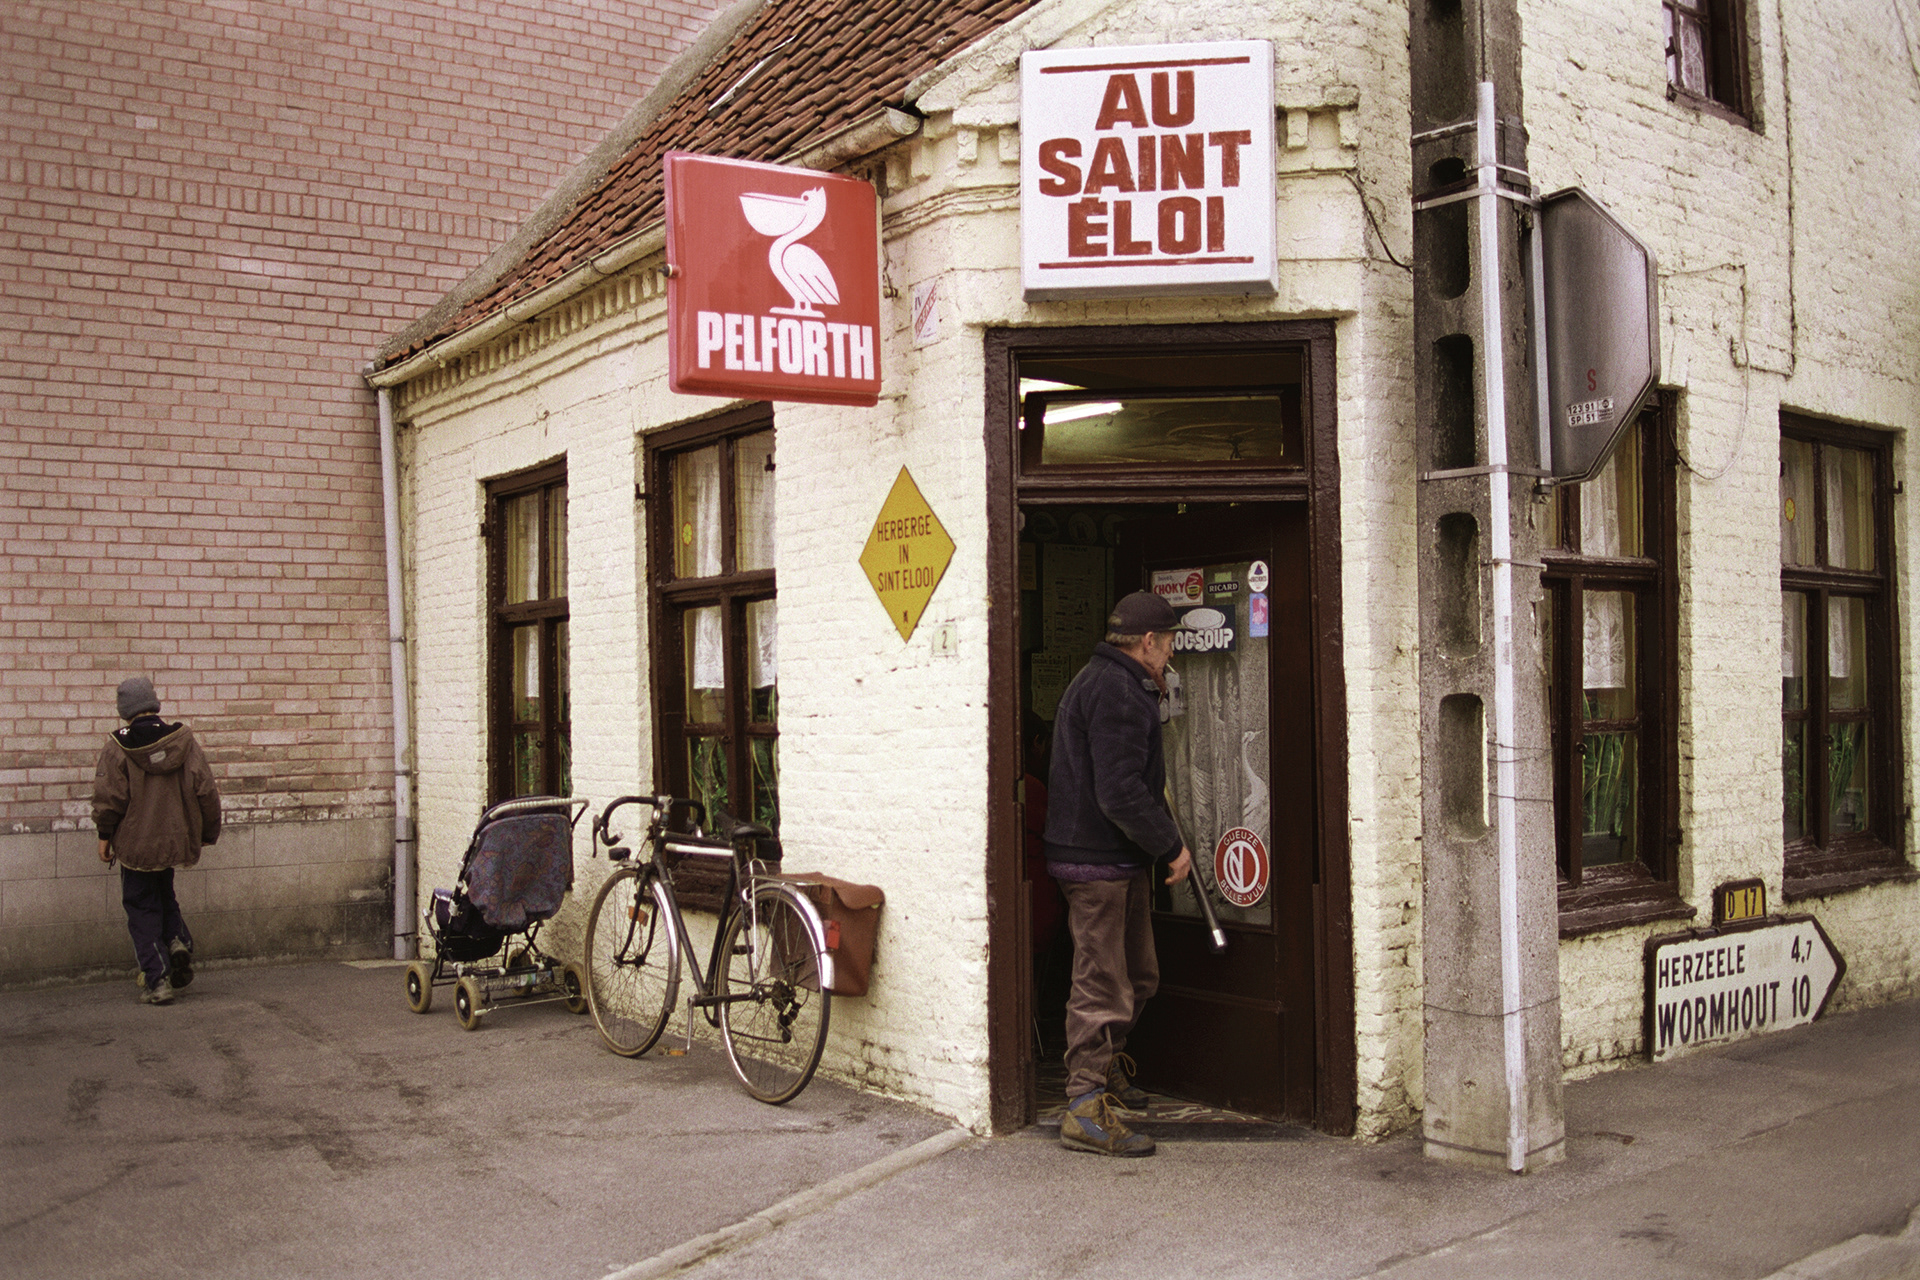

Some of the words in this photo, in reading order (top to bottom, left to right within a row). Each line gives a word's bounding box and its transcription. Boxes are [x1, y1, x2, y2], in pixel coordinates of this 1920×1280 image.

[1095, 70, 1195, 130] AU
[1039, 130, 1252, 197] SAINT
[1068, 196, 1225, 258] ÉLOI
[697, 310, 875, 381] PELFORTH
[1587, 368, 1596, 391] S
[1570, 415, 1582, 425] SP
[877, 514, 932, 542] HERBERGE
[899, 544, 909, 565] IN
[878, 570, 900, 592] SINT
[903, 566, 934, 589] ELOOI
[1153, 582, 1185, 595] CHOKY
[1208, 583, 1239, 593] RICARD
[1223, 830, 1259, 848] GUEUZE
[1728, 890, 1736, 919] D
[1744, 886, 1757, 917] 17
[1659, 944, 1746, 989] HERZEELE
[1658, 980, 1780, 1049] WORMHOUT
[1791, 974, 1811, 1019] 10
